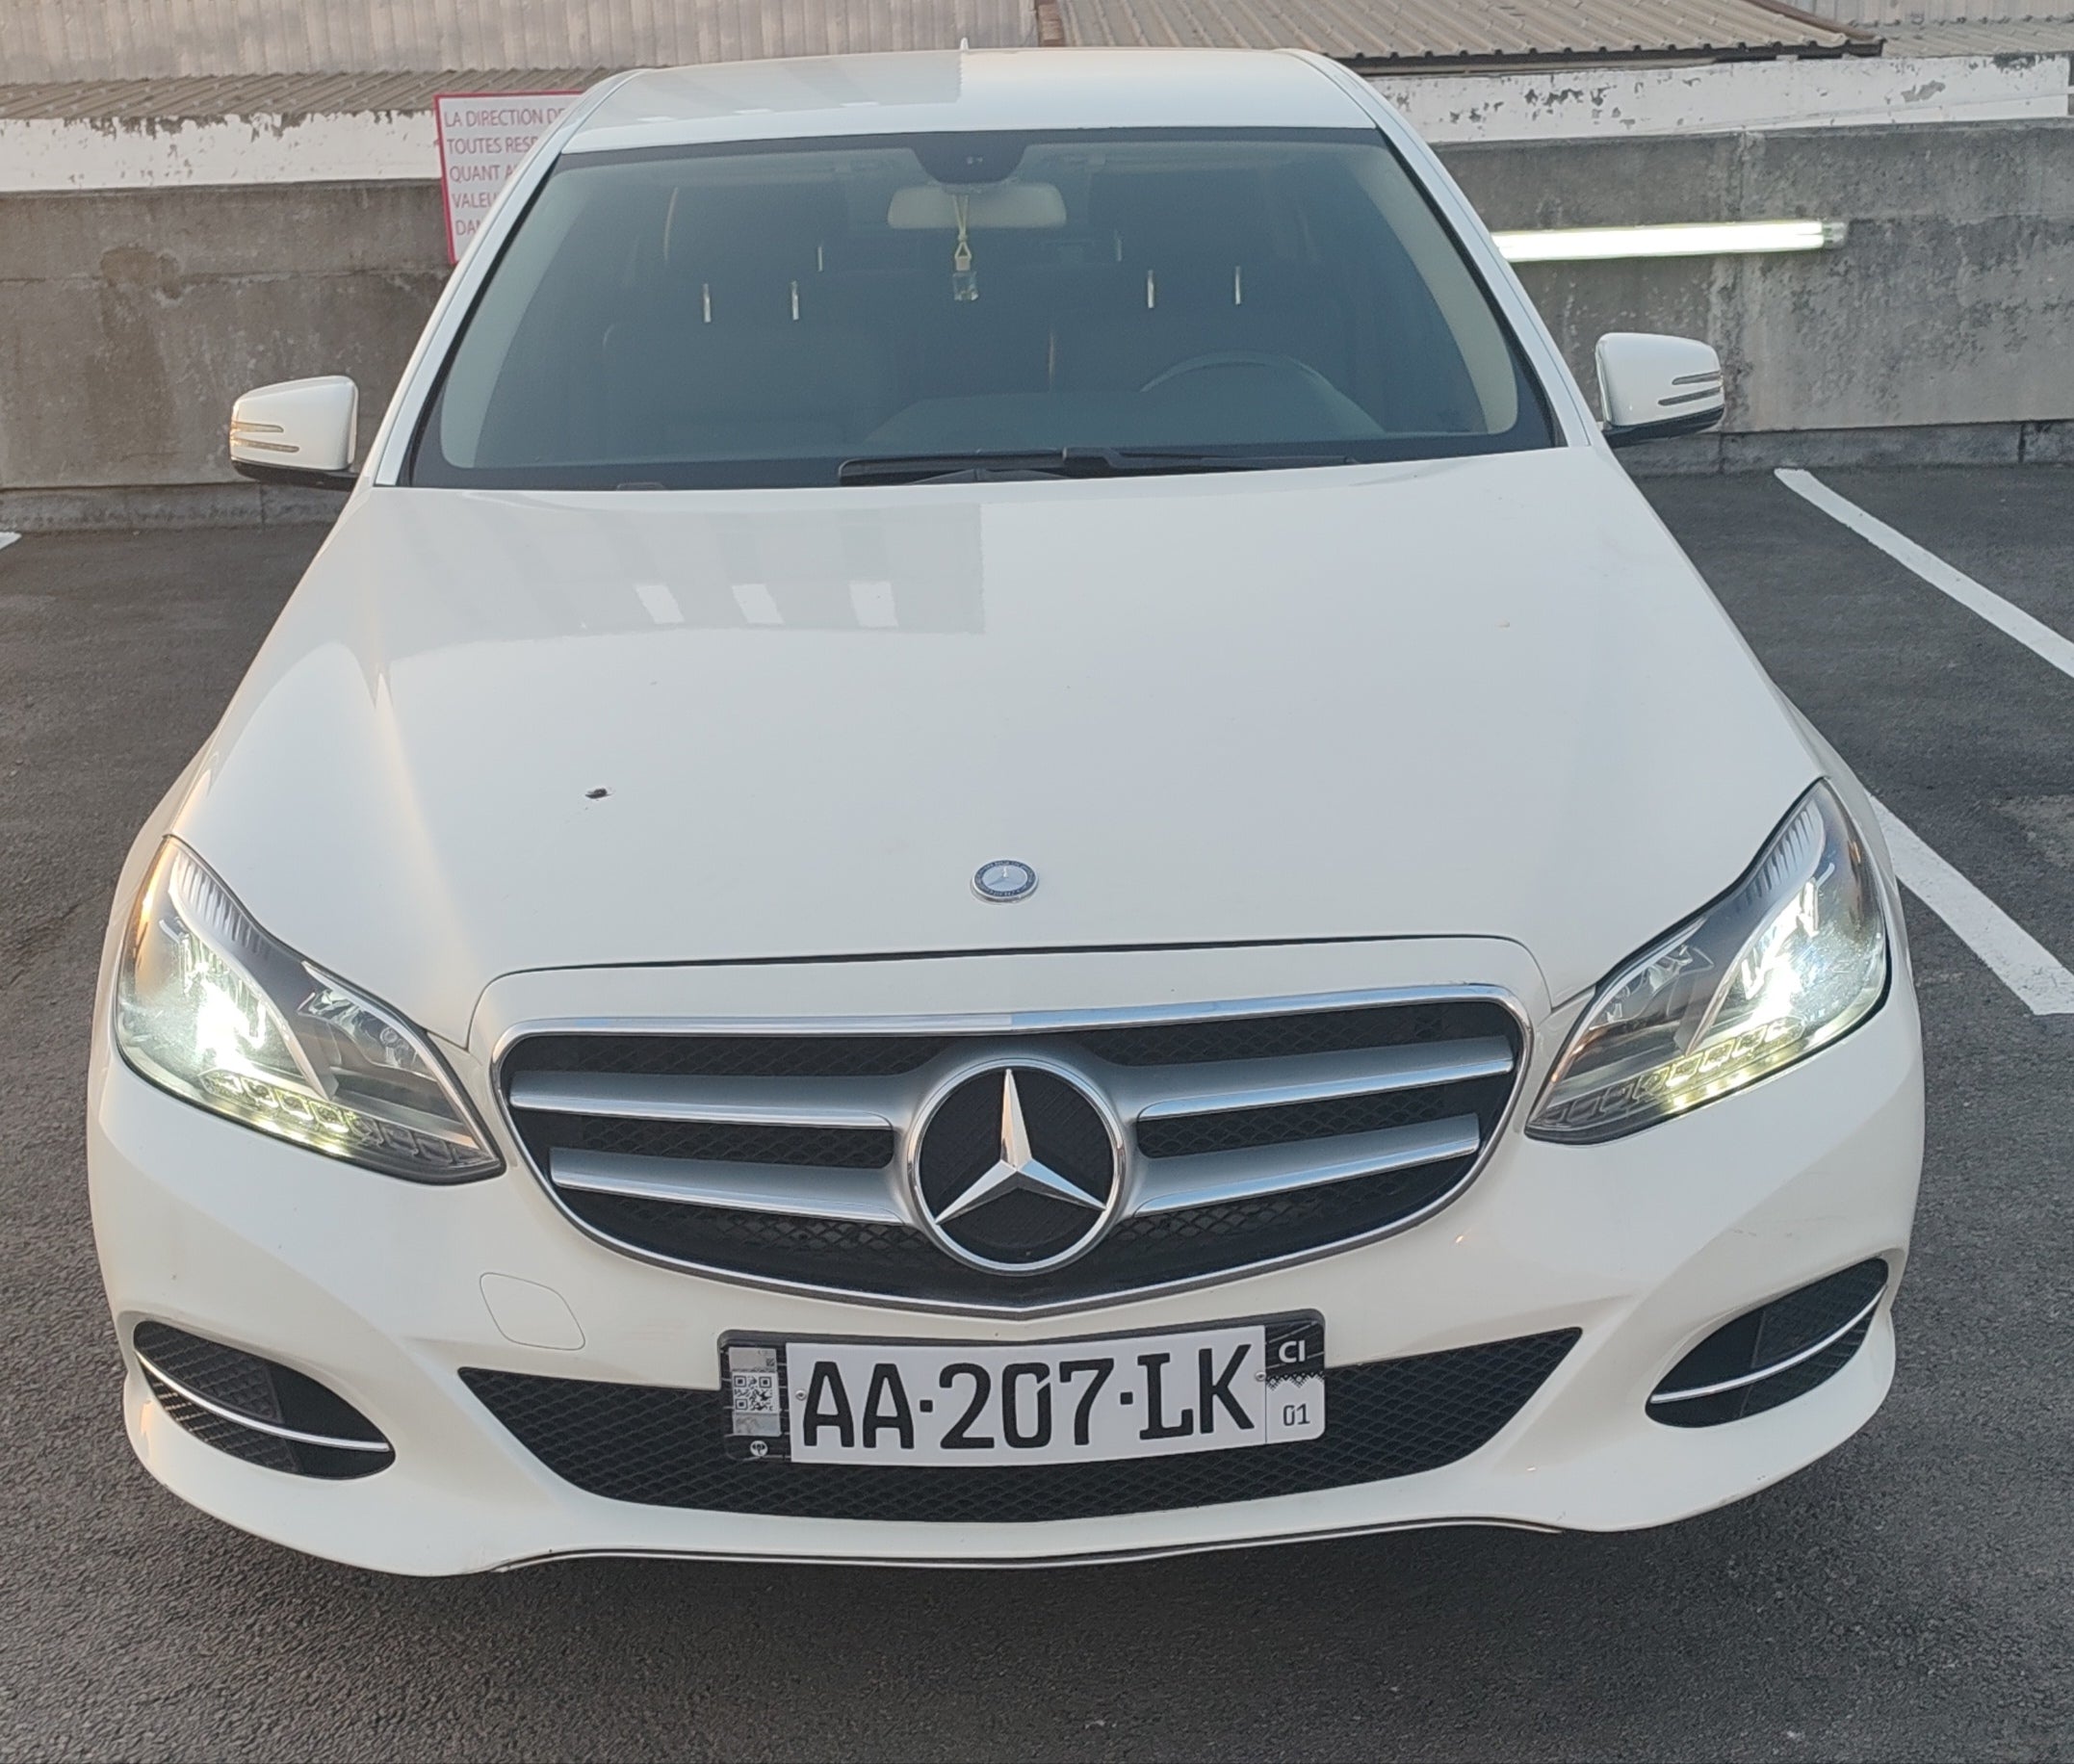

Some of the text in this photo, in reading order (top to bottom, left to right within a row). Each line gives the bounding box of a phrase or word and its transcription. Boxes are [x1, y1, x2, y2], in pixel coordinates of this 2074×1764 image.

[444, 111, 462, 127] LA
[466, 108, 544, 127] DIRECTION
[447, 137, 502, 154] TOUTES
[450, 165, 500, 183] QUANT
[1279, 1339, 1306, 1363] CI
[1283, 1403, 1310, 1426] 01
